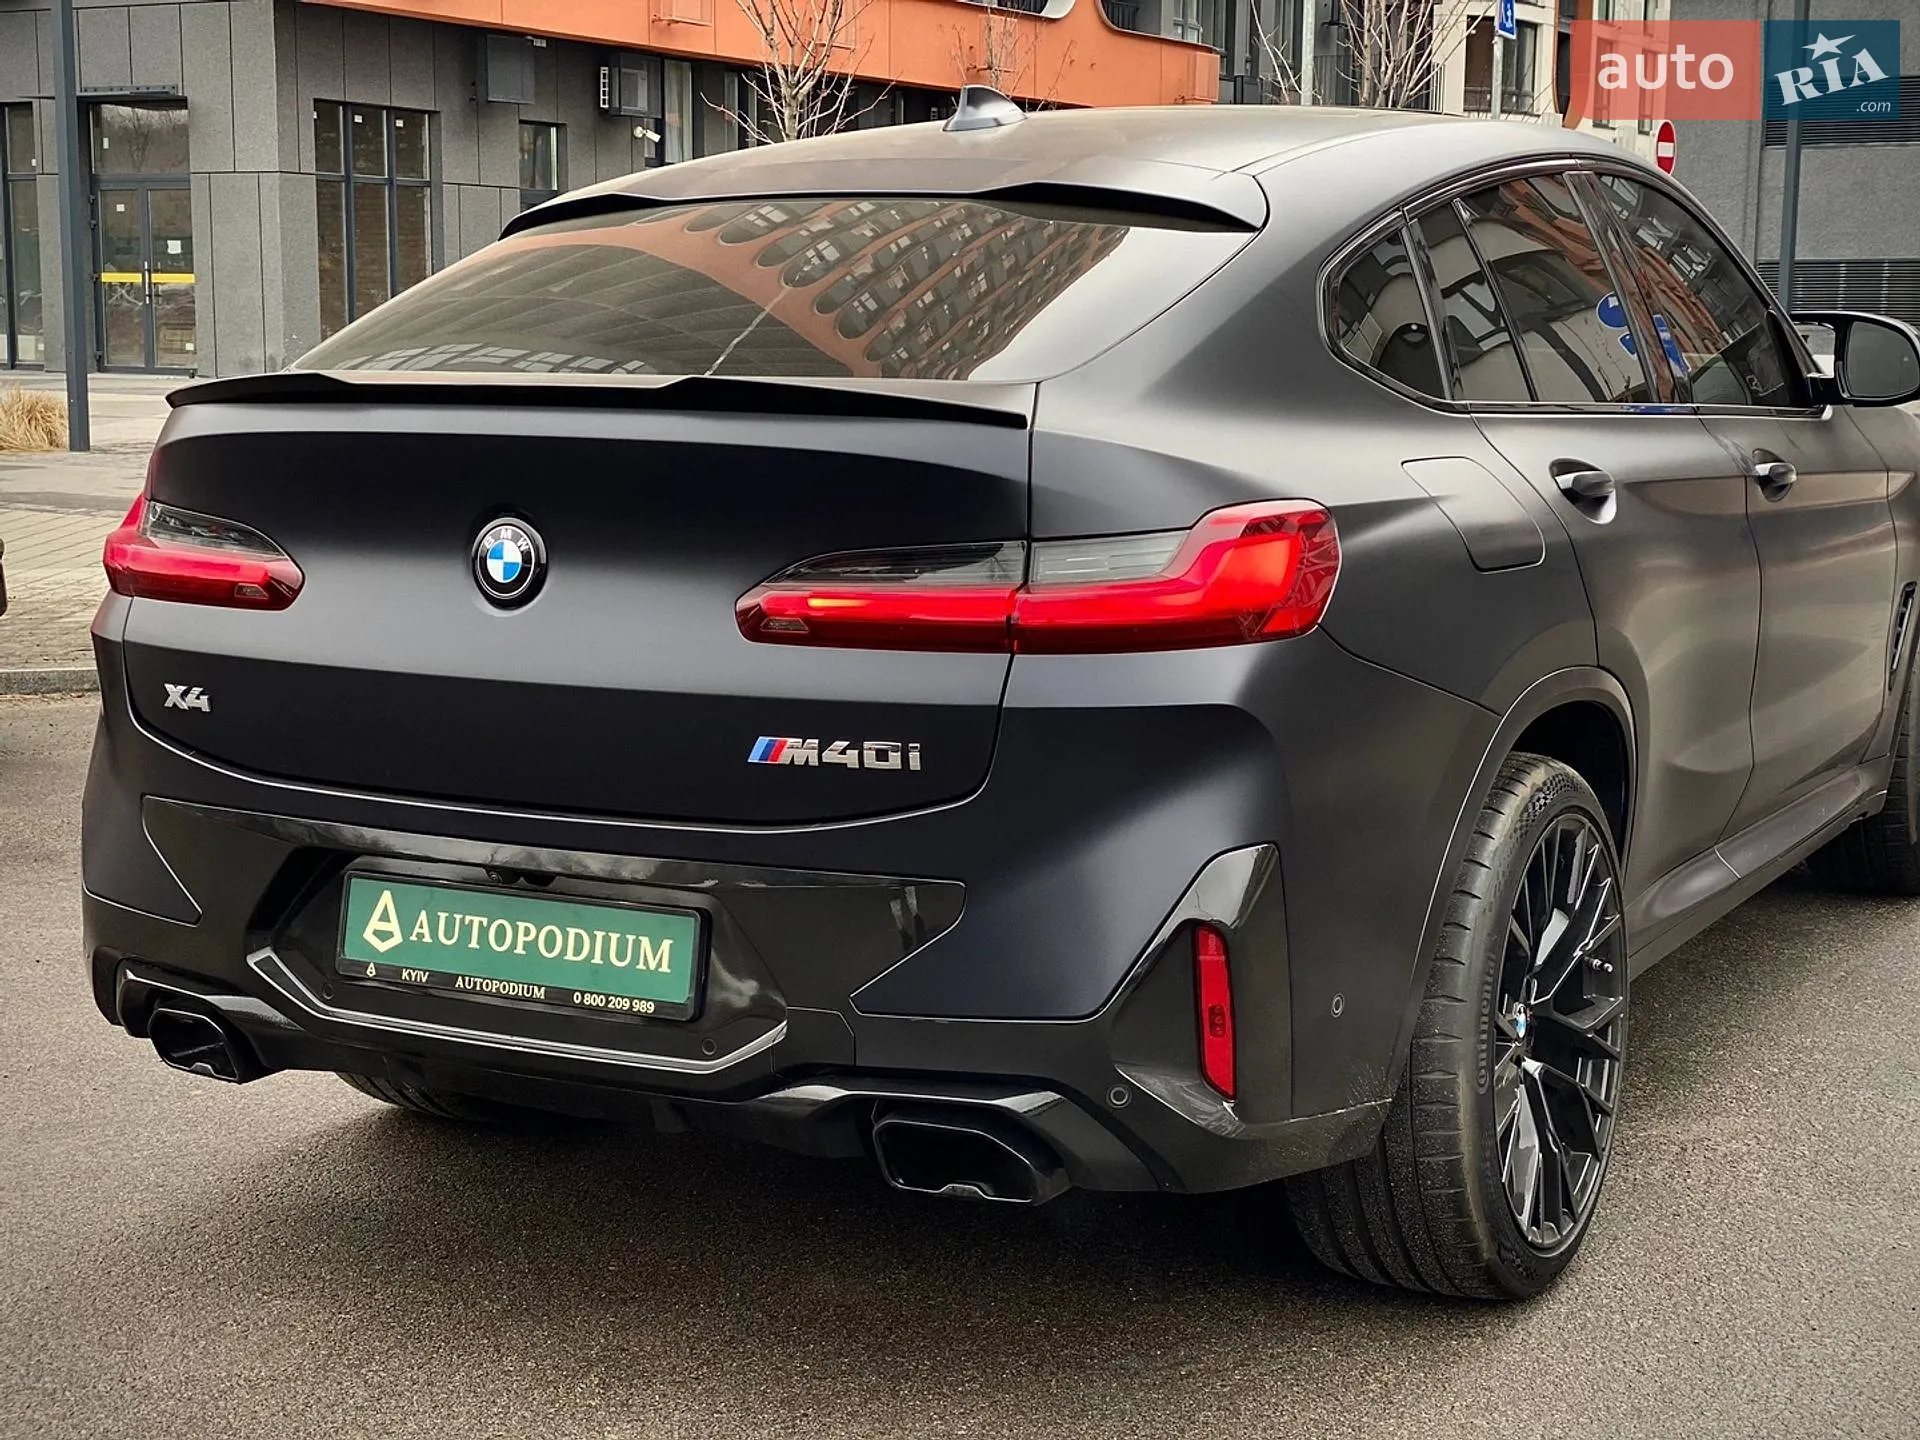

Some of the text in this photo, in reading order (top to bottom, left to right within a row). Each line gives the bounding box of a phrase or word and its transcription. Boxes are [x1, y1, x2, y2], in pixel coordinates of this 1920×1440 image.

[483, 528, 530, 551] BMW
[164, 683, 211, 712] X4
[780, 737, 921, 771] M40i
[409, 909, 674, 973] AUTOPODIUM
[401, 968, 655, 1013] KYIV AUTOPODIUM 0 800 209 989
